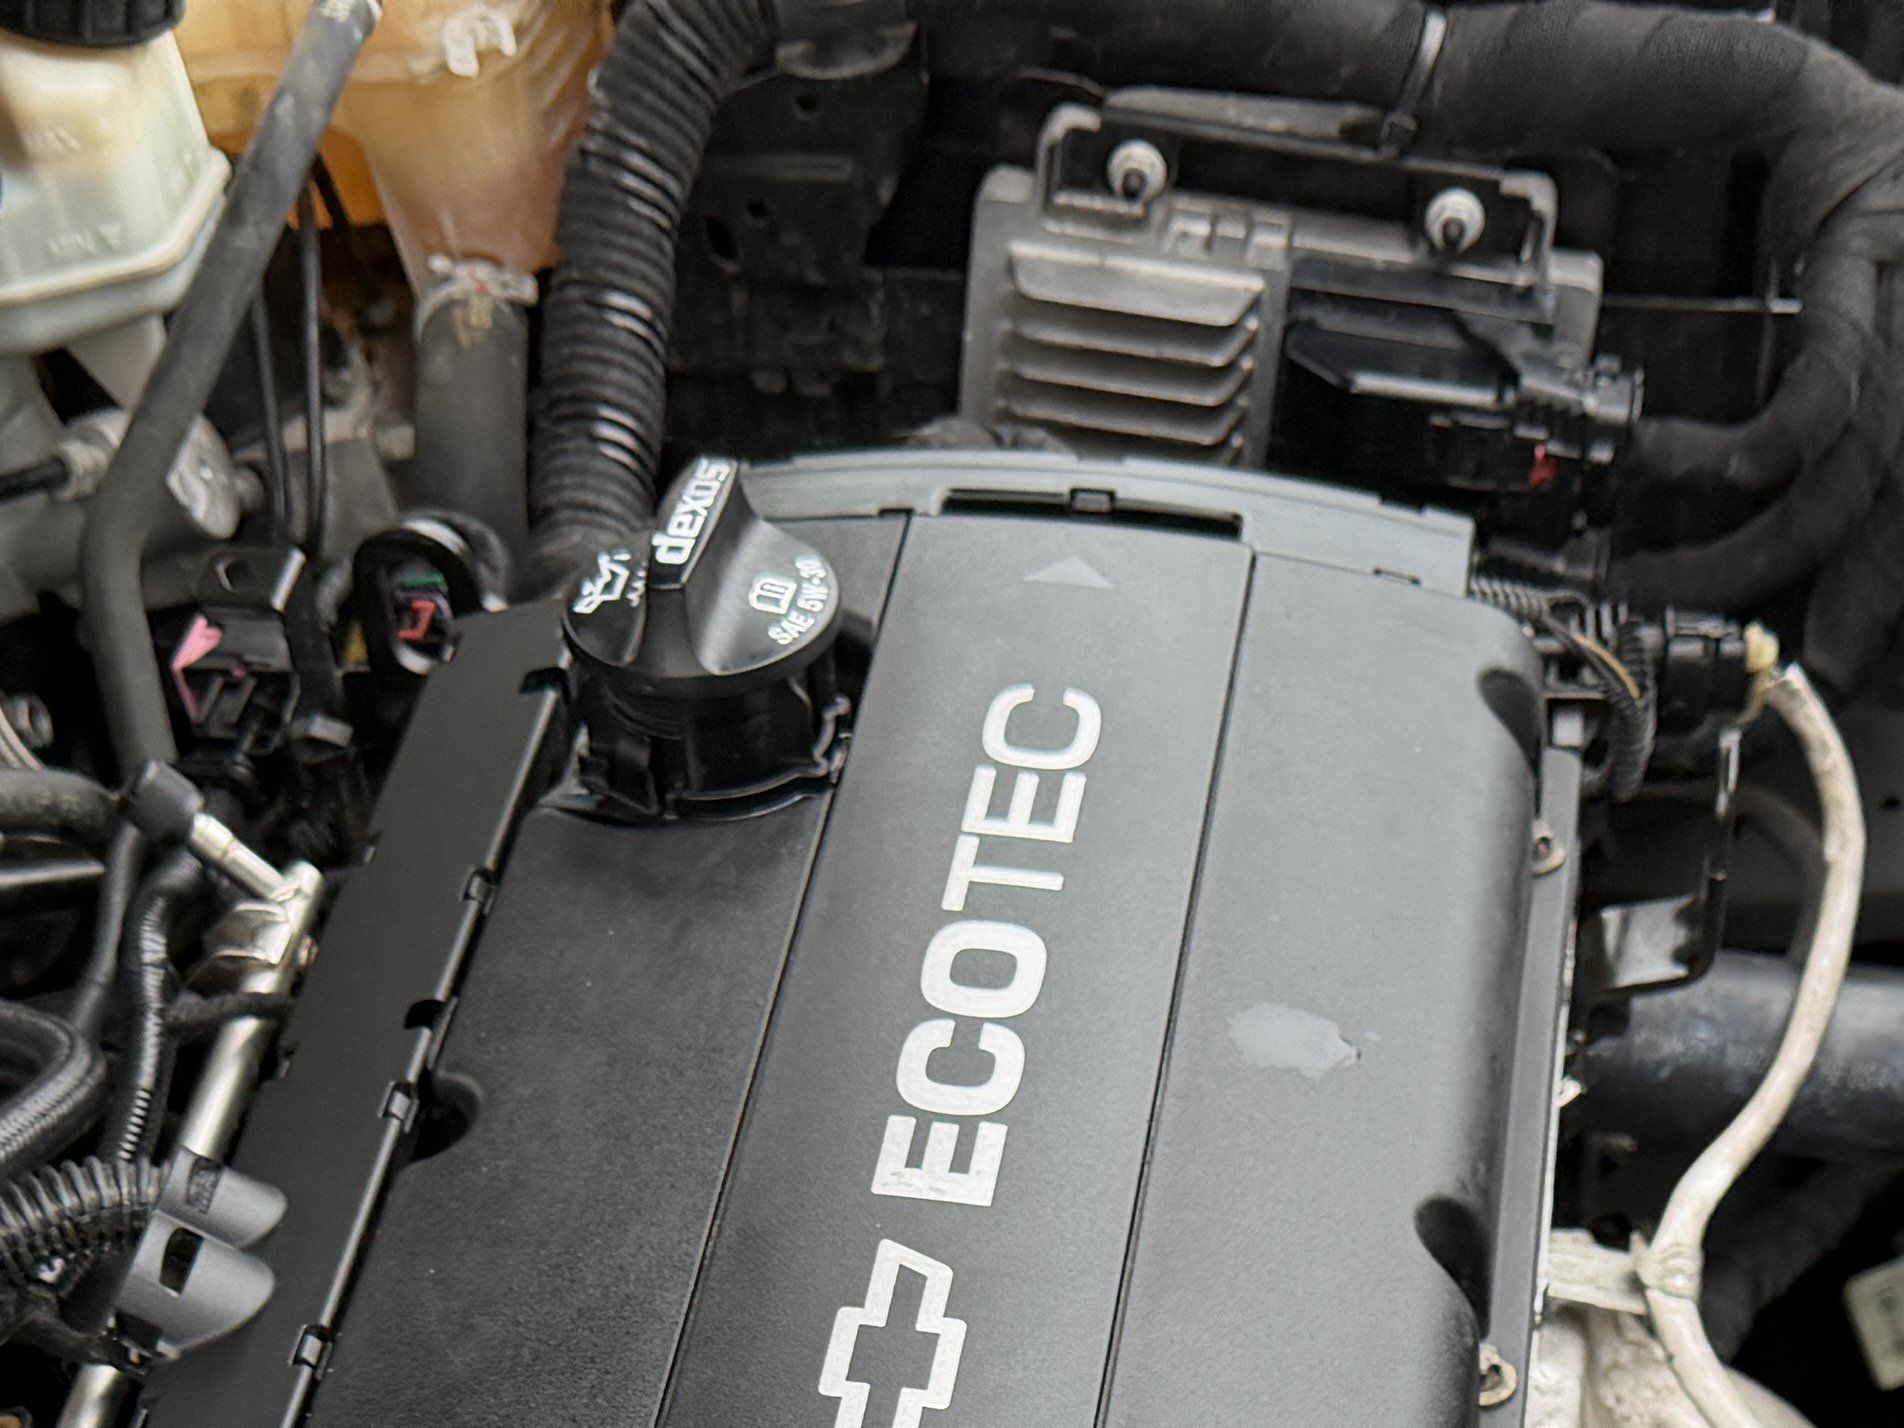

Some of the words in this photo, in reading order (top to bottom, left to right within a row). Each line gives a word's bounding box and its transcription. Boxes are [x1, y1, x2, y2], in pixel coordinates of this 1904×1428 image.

[652, 456, 730, 564] dexos
[767, 611, 815, 645] SAE
[871, 684, 1102, 1206] ECOTEC
